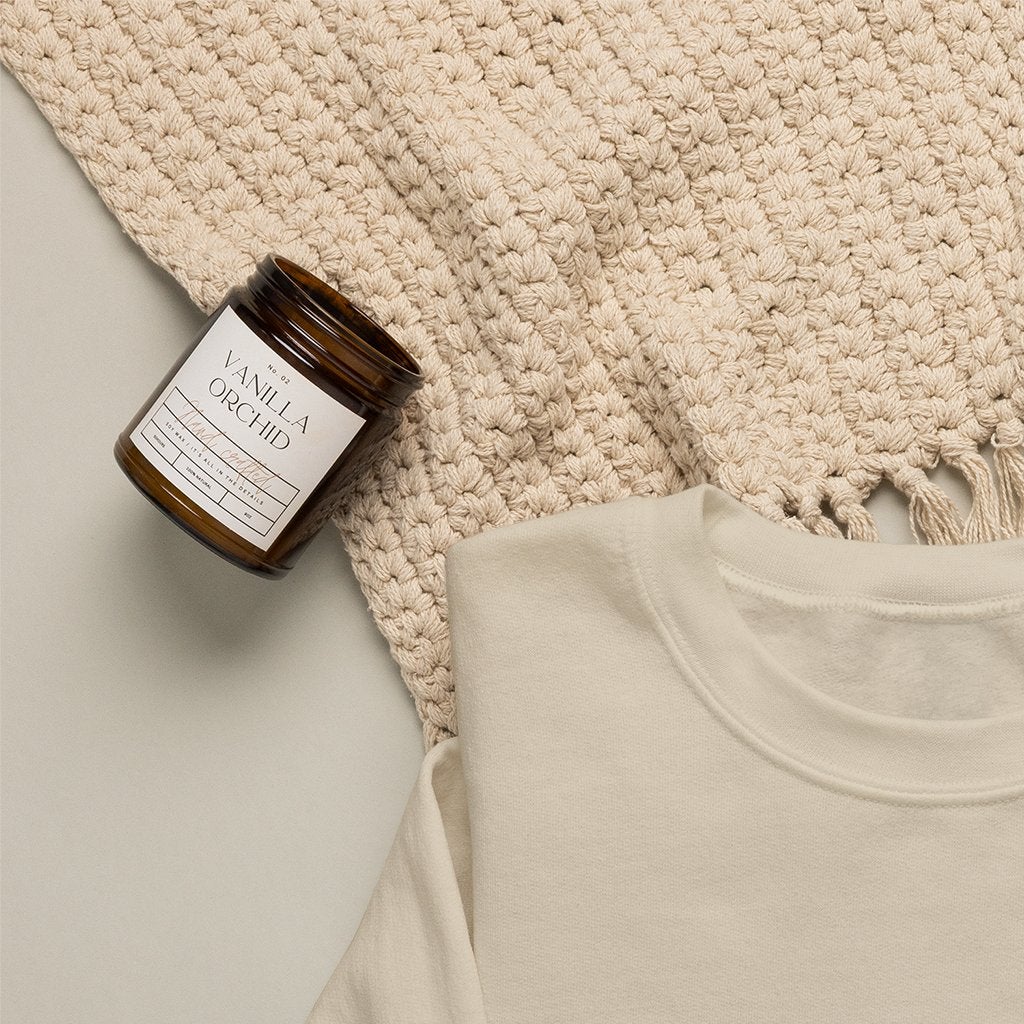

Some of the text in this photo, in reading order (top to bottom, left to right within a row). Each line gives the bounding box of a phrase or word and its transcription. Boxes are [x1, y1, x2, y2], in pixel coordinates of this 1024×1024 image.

[225, 349, 309, 434] VANILLA
[280, 375, 290, 385] 02
[209, 377, 290, 450] ORCHID
[203, 458, 214, 469] ALL
[225, 475, 237, 486] THE
[238, 485, 264, 506] DETAILS
